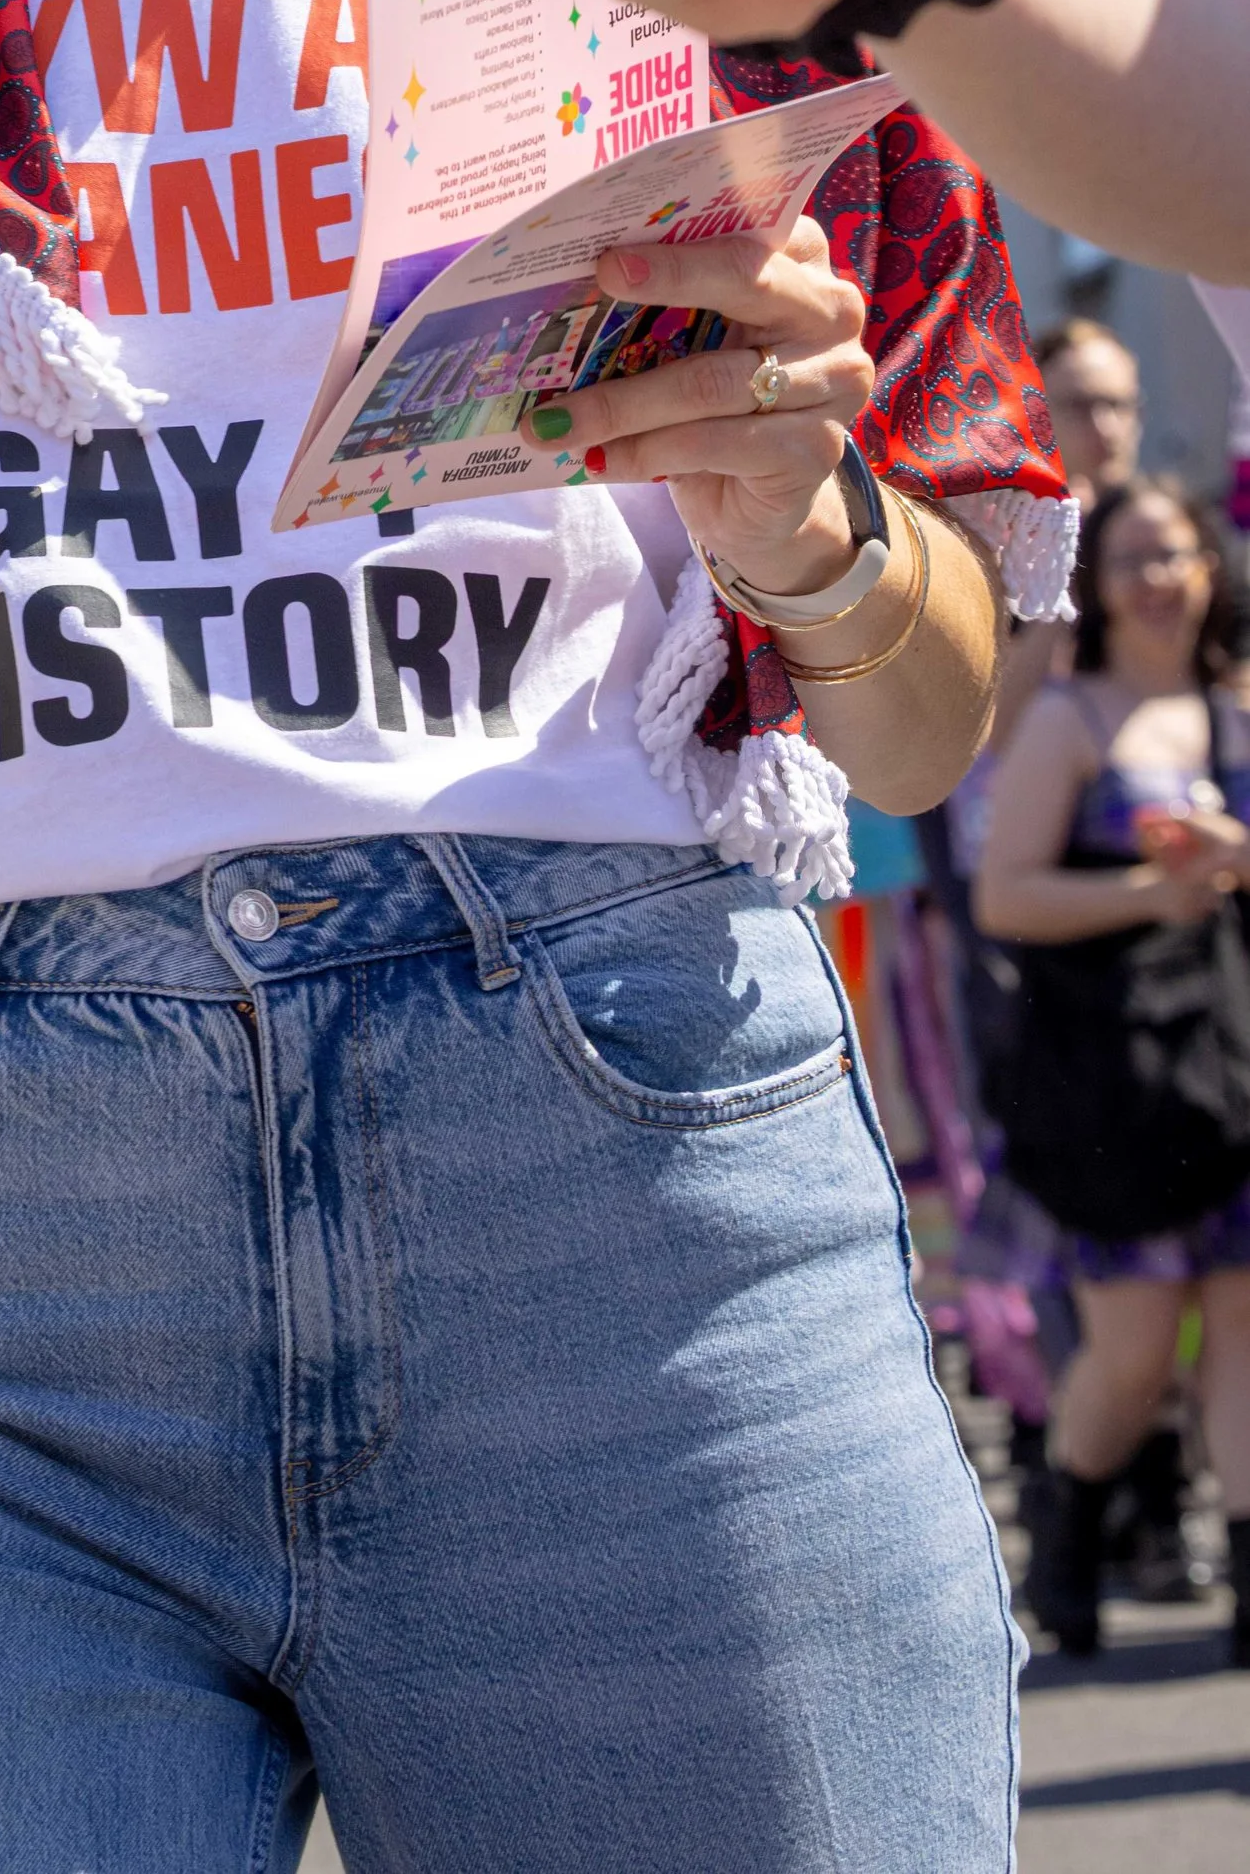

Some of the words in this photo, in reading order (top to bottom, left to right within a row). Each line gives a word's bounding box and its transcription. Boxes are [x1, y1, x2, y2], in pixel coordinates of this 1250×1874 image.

[446, 1, 461, 14] and
[490, 3, 513, 18] Silent
[420, 8, 443, 23] More!
[465, 11, 488, 25] Disco
[516, 15, 532, 28] Mini
[487, 22, 514, 37] Parade
[630, 16, 684, 47] ational
[500, 33, 533, 53] Rainbow
[474, 46, 498, 61] crafts
[516, 52, 534, 65] Face
[481, 59, 514, 77] Painting
[521, 70, 535, 82] Fun
[609, 44, 692, 116] PRIDE
[477, 75, 518, 98] walkabout
[431, 91, 475, 112] characters
[511, 88, 536, 103] Family
[483, 98, 508, 113] Picnic
[504, 104, 544, 124] Featuring:
[593, 92, 693, 171] FAMILY
[508, 134, 545, 153] whoever
[489, 145, 504, 159] you
[522, 149, 546, 163] being
[451, 162, 460, 173] to
[463, 153, 486, 169] want
[490, 157, 520, 173] happy,
[434, 166, 448, 177] be.
[461, 166, 488, 185] proud
[529, 164, 546, 176] fun,
[440, 178, 458, 193] and
[498, 171, 526, 189] family
[535, 179, 546, 192] All
[457, 190, 466, 200] to
[470, 181, 495, 196] event
[518, 185, 533, 196] are
[701, 164, 815, 212] PRIDE
[408, 195, 454, 215] celebrate
[474, 190, 515, 209] welcome
[440, 209, 458, 221] this
[461, 204, 471, 215] at
[62, 133, 368, 315] ANE
[657, 194, 791, 244] FAMILY
[466, 446, 520, 465] CYMRU
[441, 459, 532, 483] AMGUEDDFA
